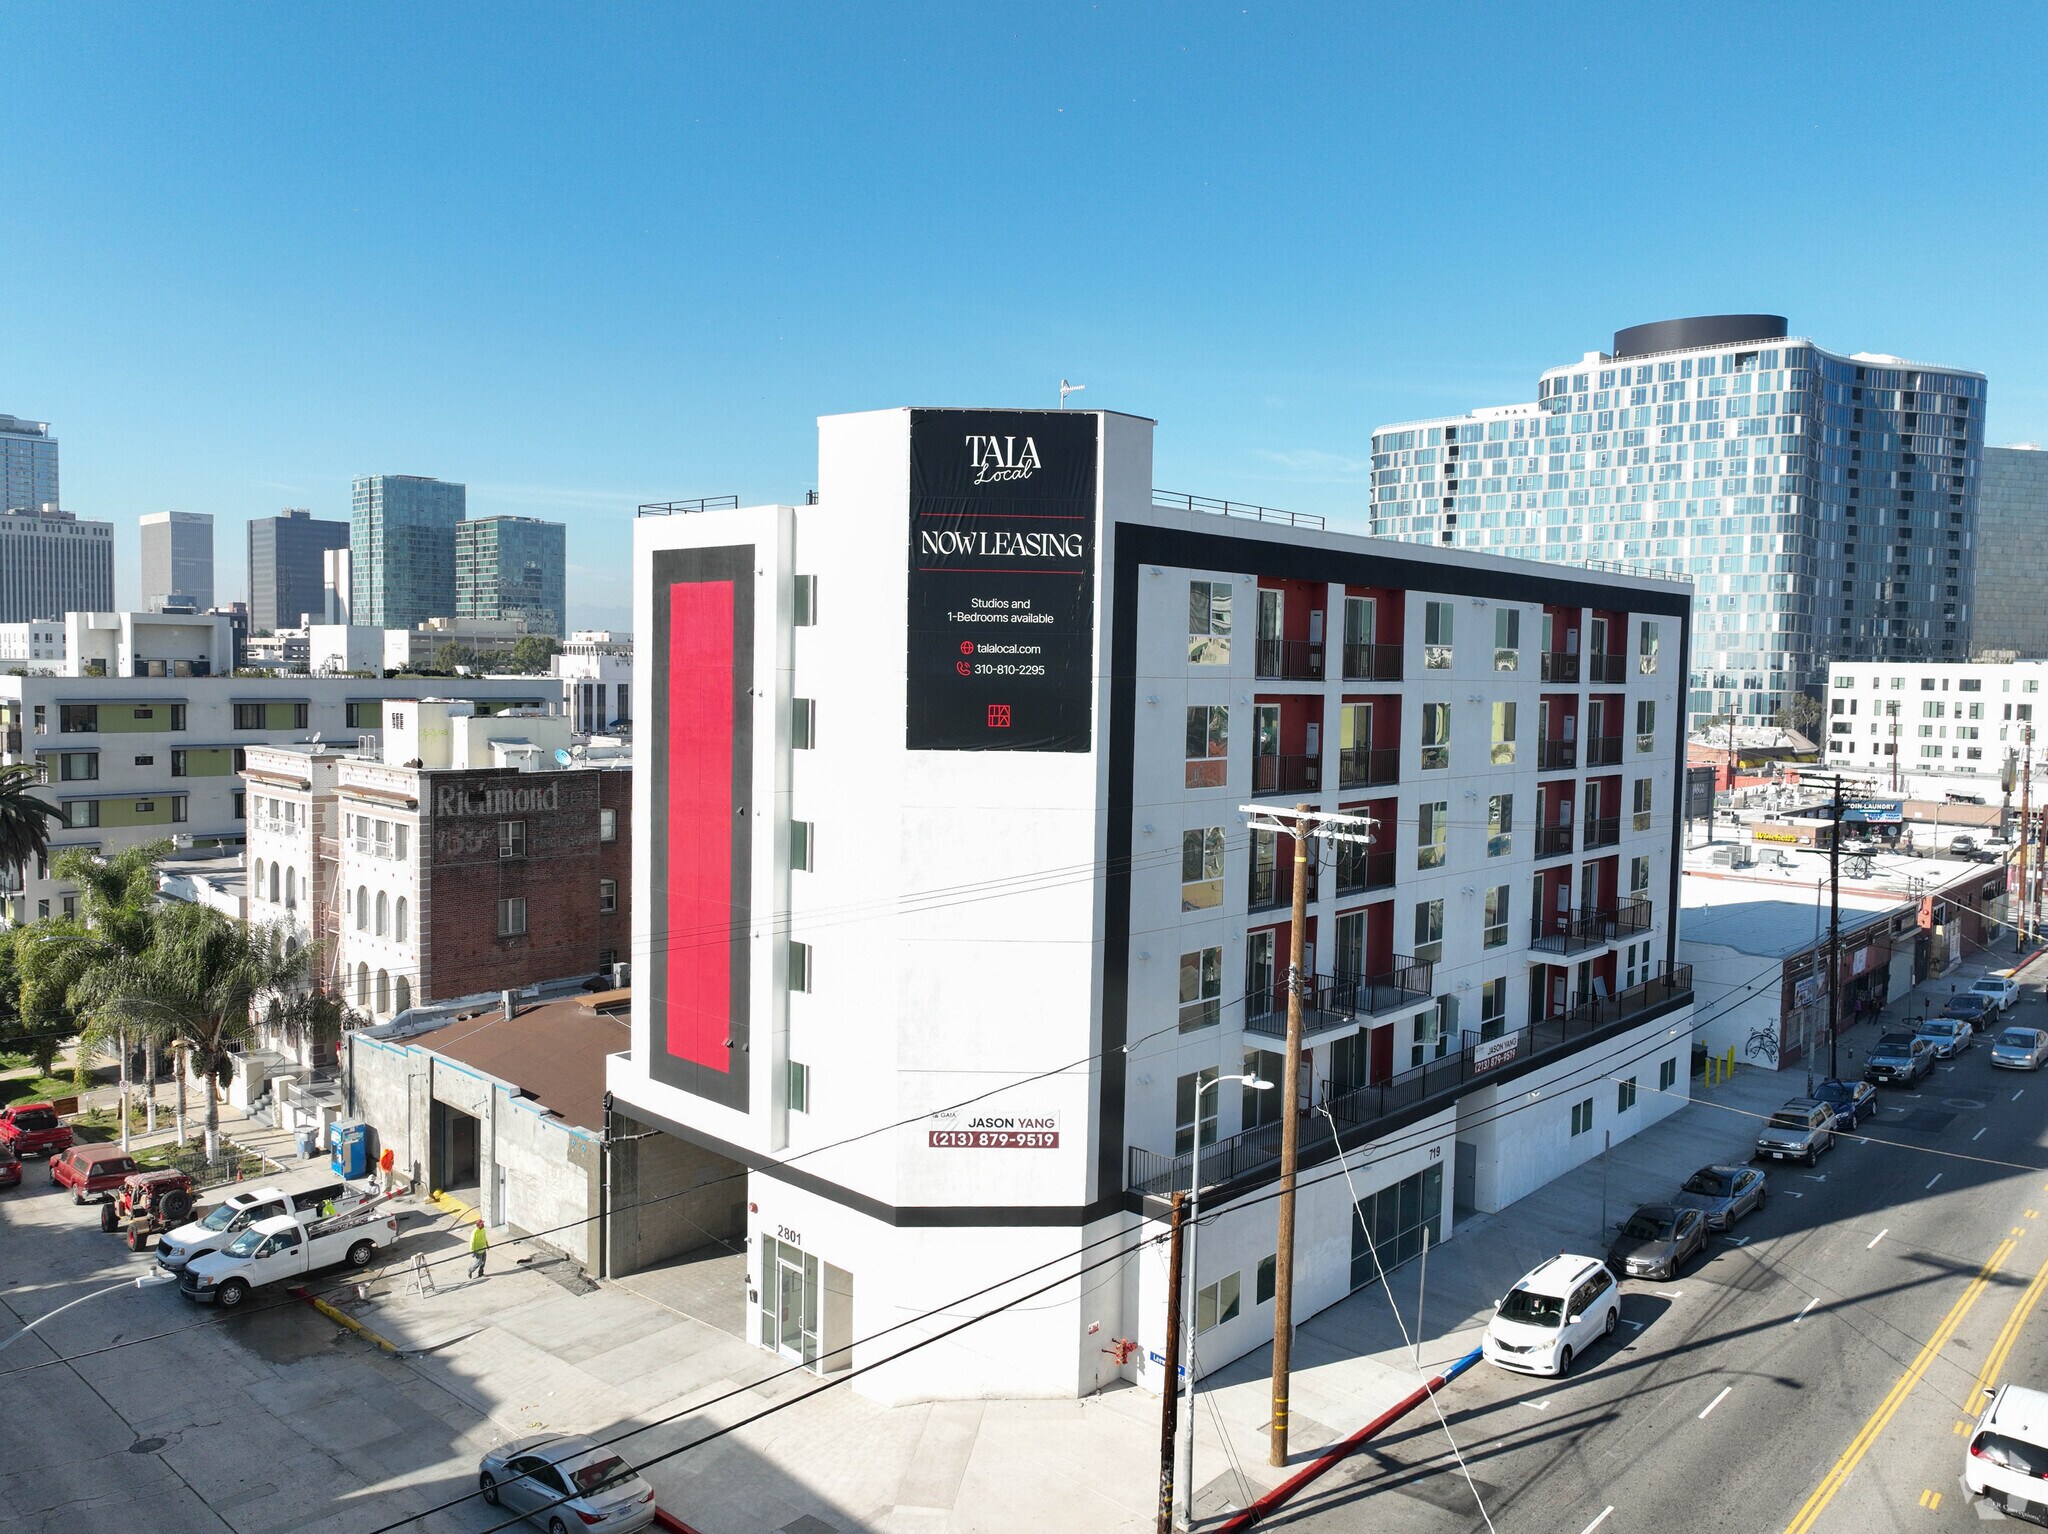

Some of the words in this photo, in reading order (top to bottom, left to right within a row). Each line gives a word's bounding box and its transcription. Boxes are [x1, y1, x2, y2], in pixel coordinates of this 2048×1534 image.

[965, 435, 1042, 469] TALA
[973, 458, 1034, 485] Local
[921, 530, 977, 555] NOW
[979, 531, 1083, 558] LEASING
[971, 597, 1009, 609] Studios
[1011, 599, 1031, 609] and
[947, 611, 1009, 623] 1-Bedrooms
[1010, 612, 1054, 624] available
[976, 643, 1041, 654] talalocal.com
[974, 664, 1045, 676] 310-810-2295
[1487, 1042, 1504, 1055] JASON
[1504, 1037, 1517, 1048] YANG
[968, 1118, 1014, 1128] JASON
[1018, 1118, 1055, 1129] YANG
[932, 1132, 974, 1147] (213)
[979, 1133, 1054, 1147] 879-9519
[1429, 1146, 1441, 1160] 719
[777, 1224, 801, 1246] 2801
